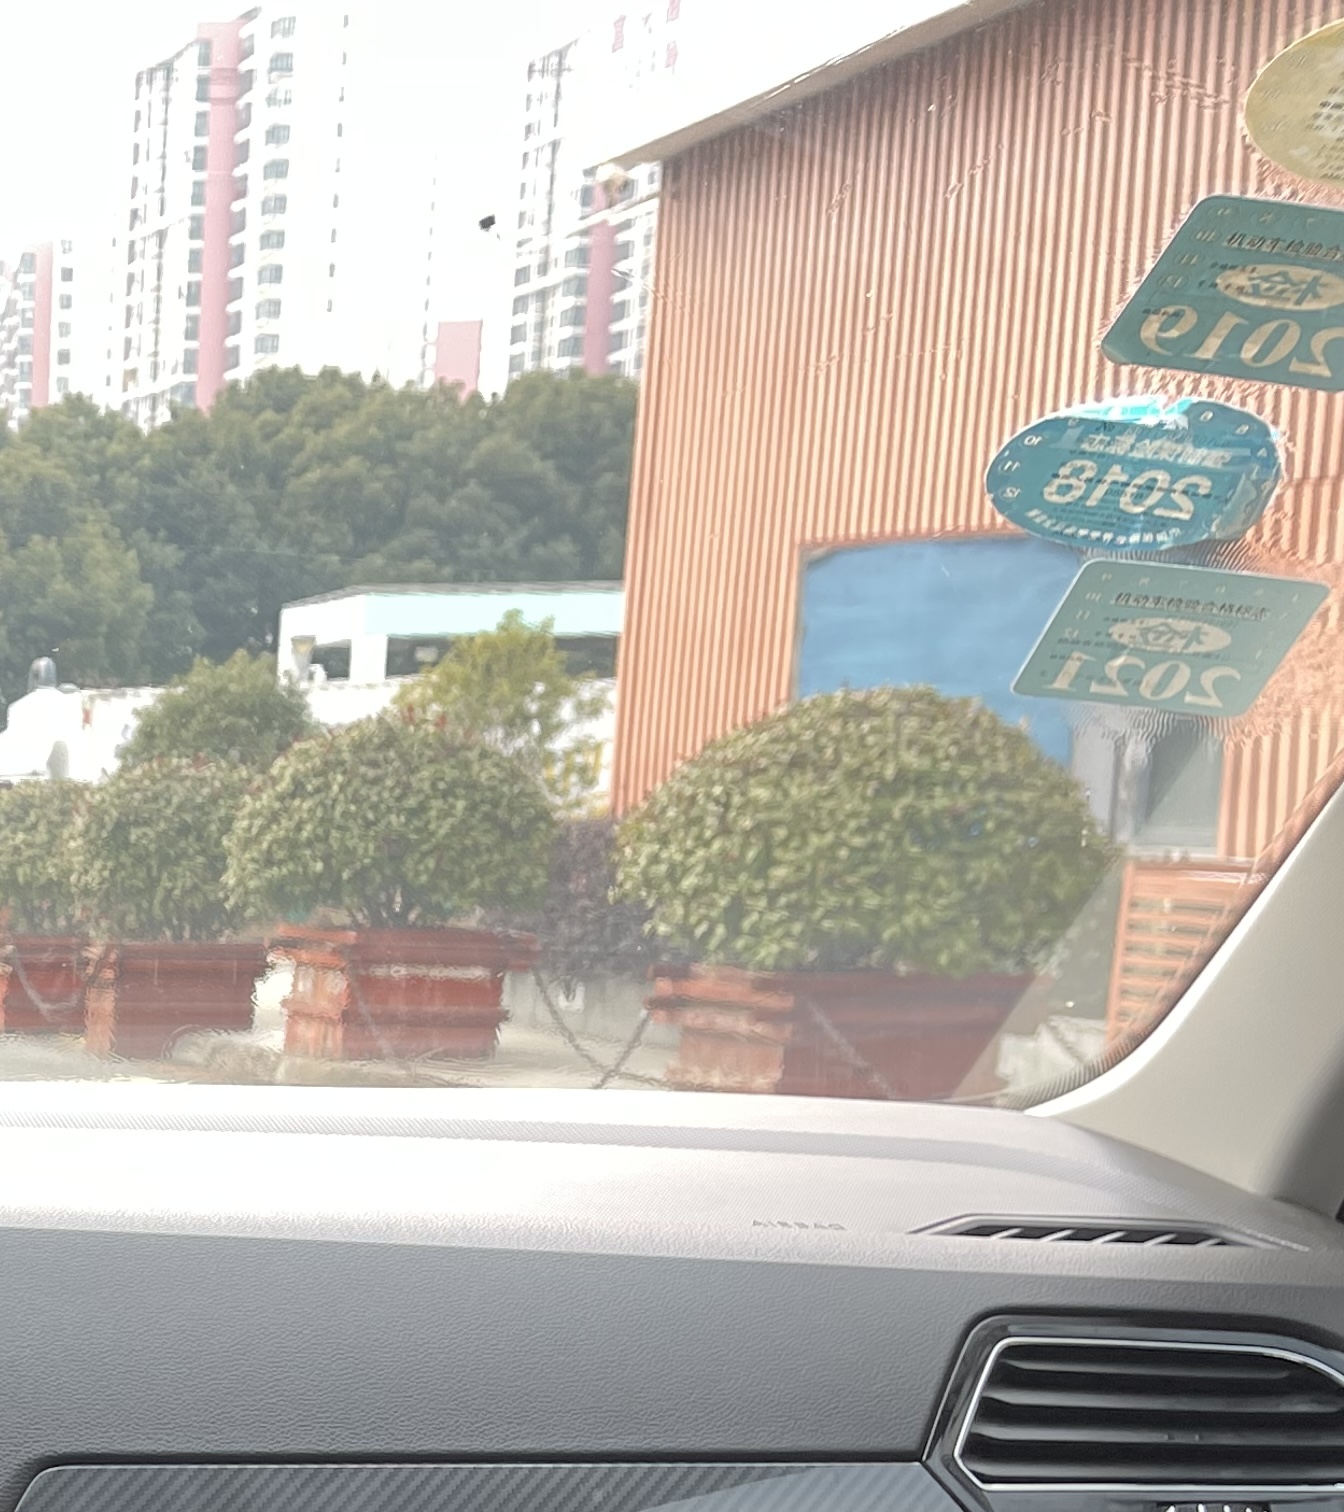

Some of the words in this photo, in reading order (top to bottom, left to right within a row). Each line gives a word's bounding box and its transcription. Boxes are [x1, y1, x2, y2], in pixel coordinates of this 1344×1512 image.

[1227, 231, 1344, 261] 机动车检验合
